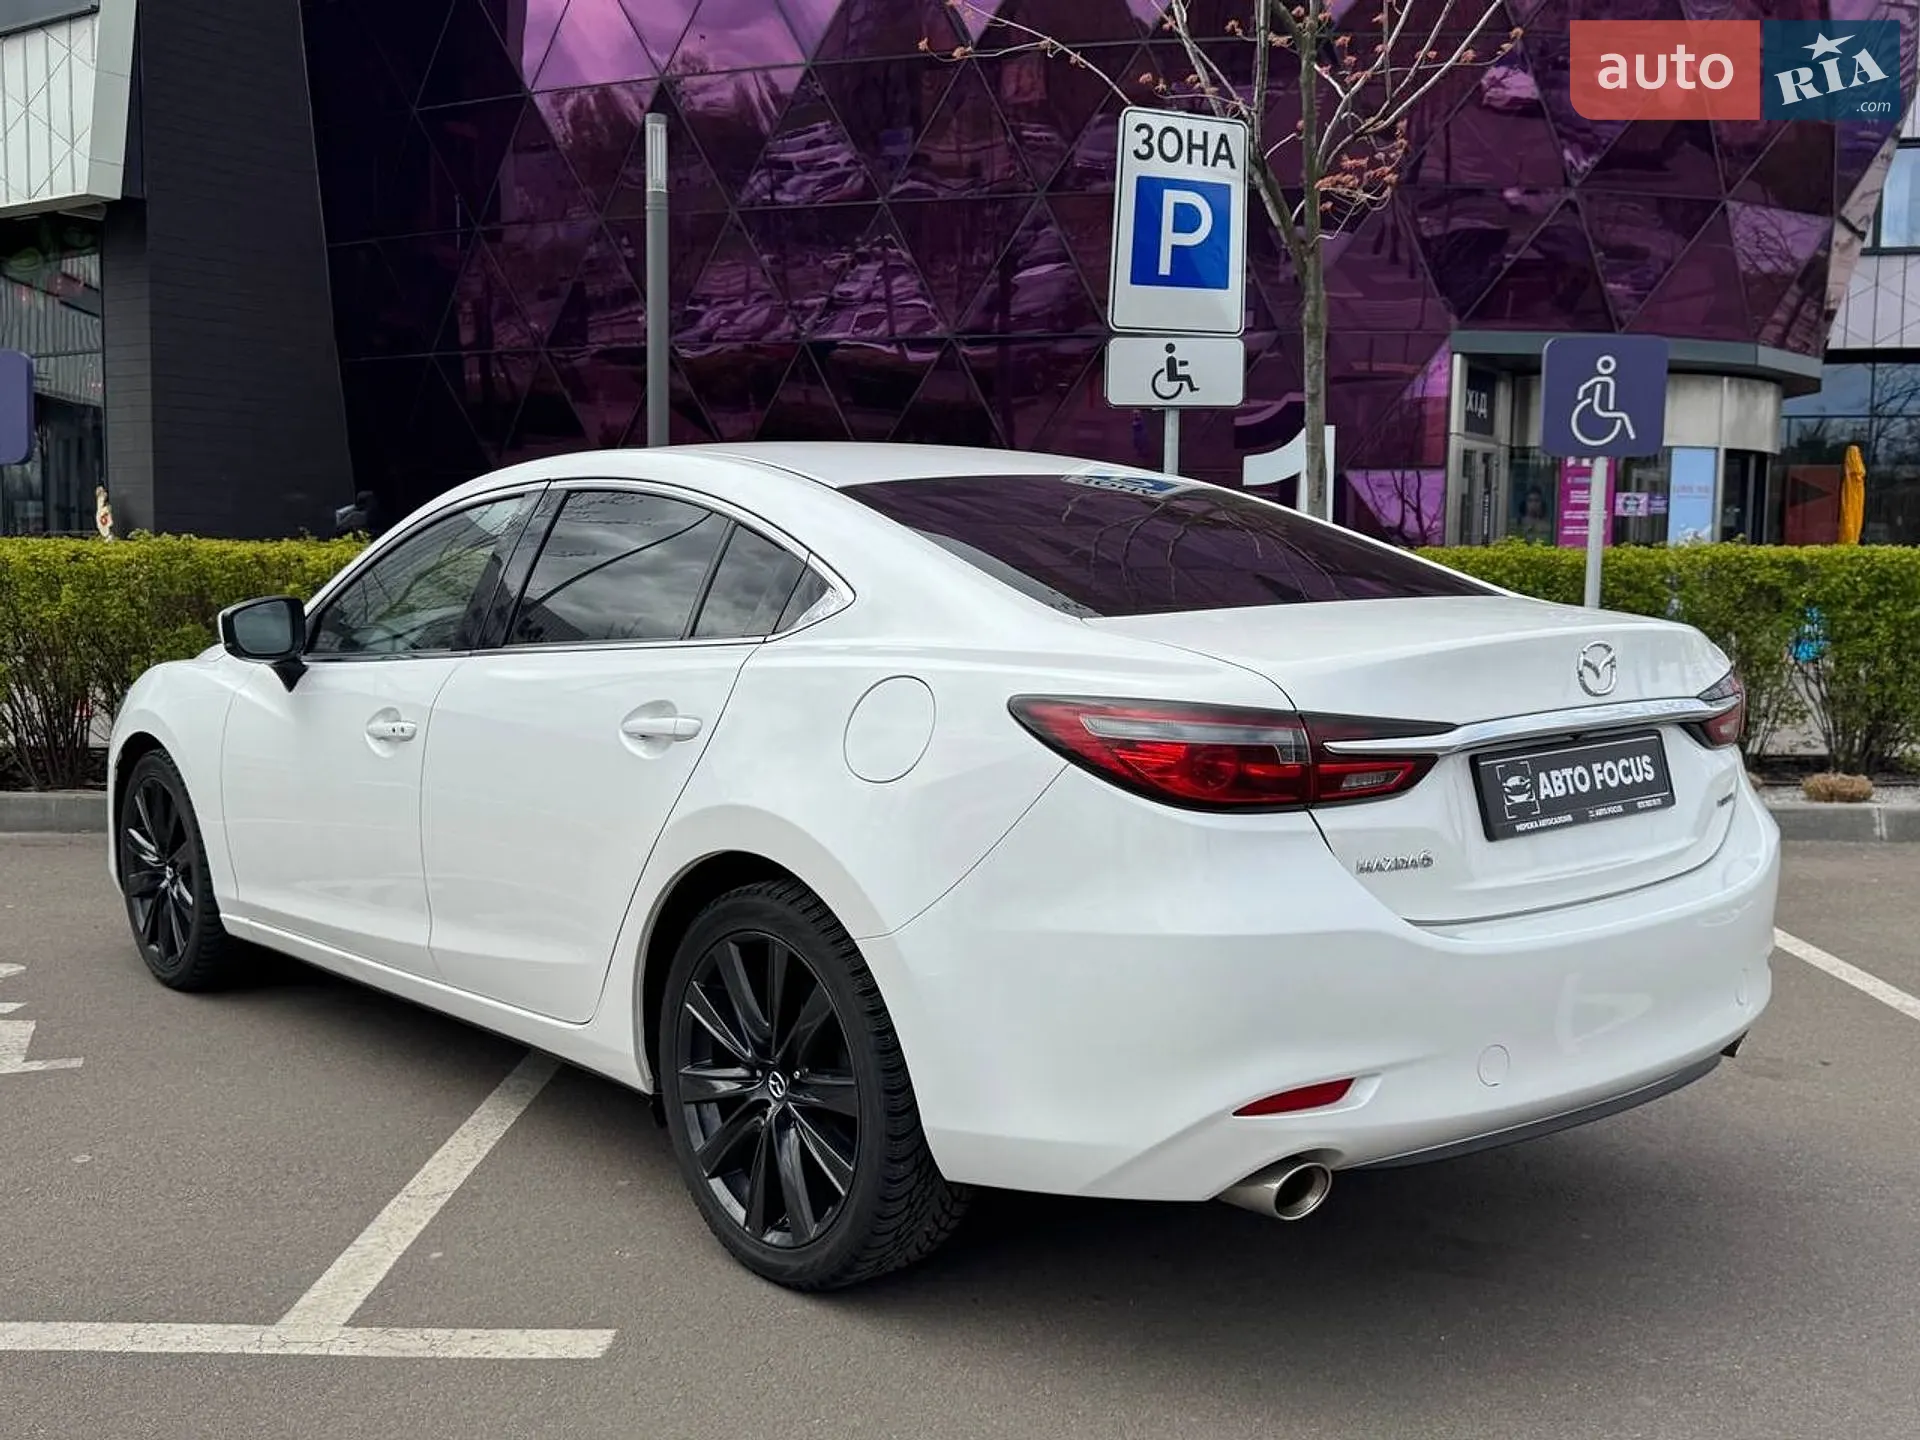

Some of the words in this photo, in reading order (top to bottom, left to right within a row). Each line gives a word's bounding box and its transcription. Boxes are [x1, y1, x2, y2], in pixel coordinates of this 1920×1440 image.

[1132, 122, 1237, 170] ЗОНА
[1158, 188, 1213, 276] P
[1466, 388, 1488, 419] ХІД
[1538, 765, 1590, 800] АВТО
[1591, 754, 1655, 790] FOCUS
